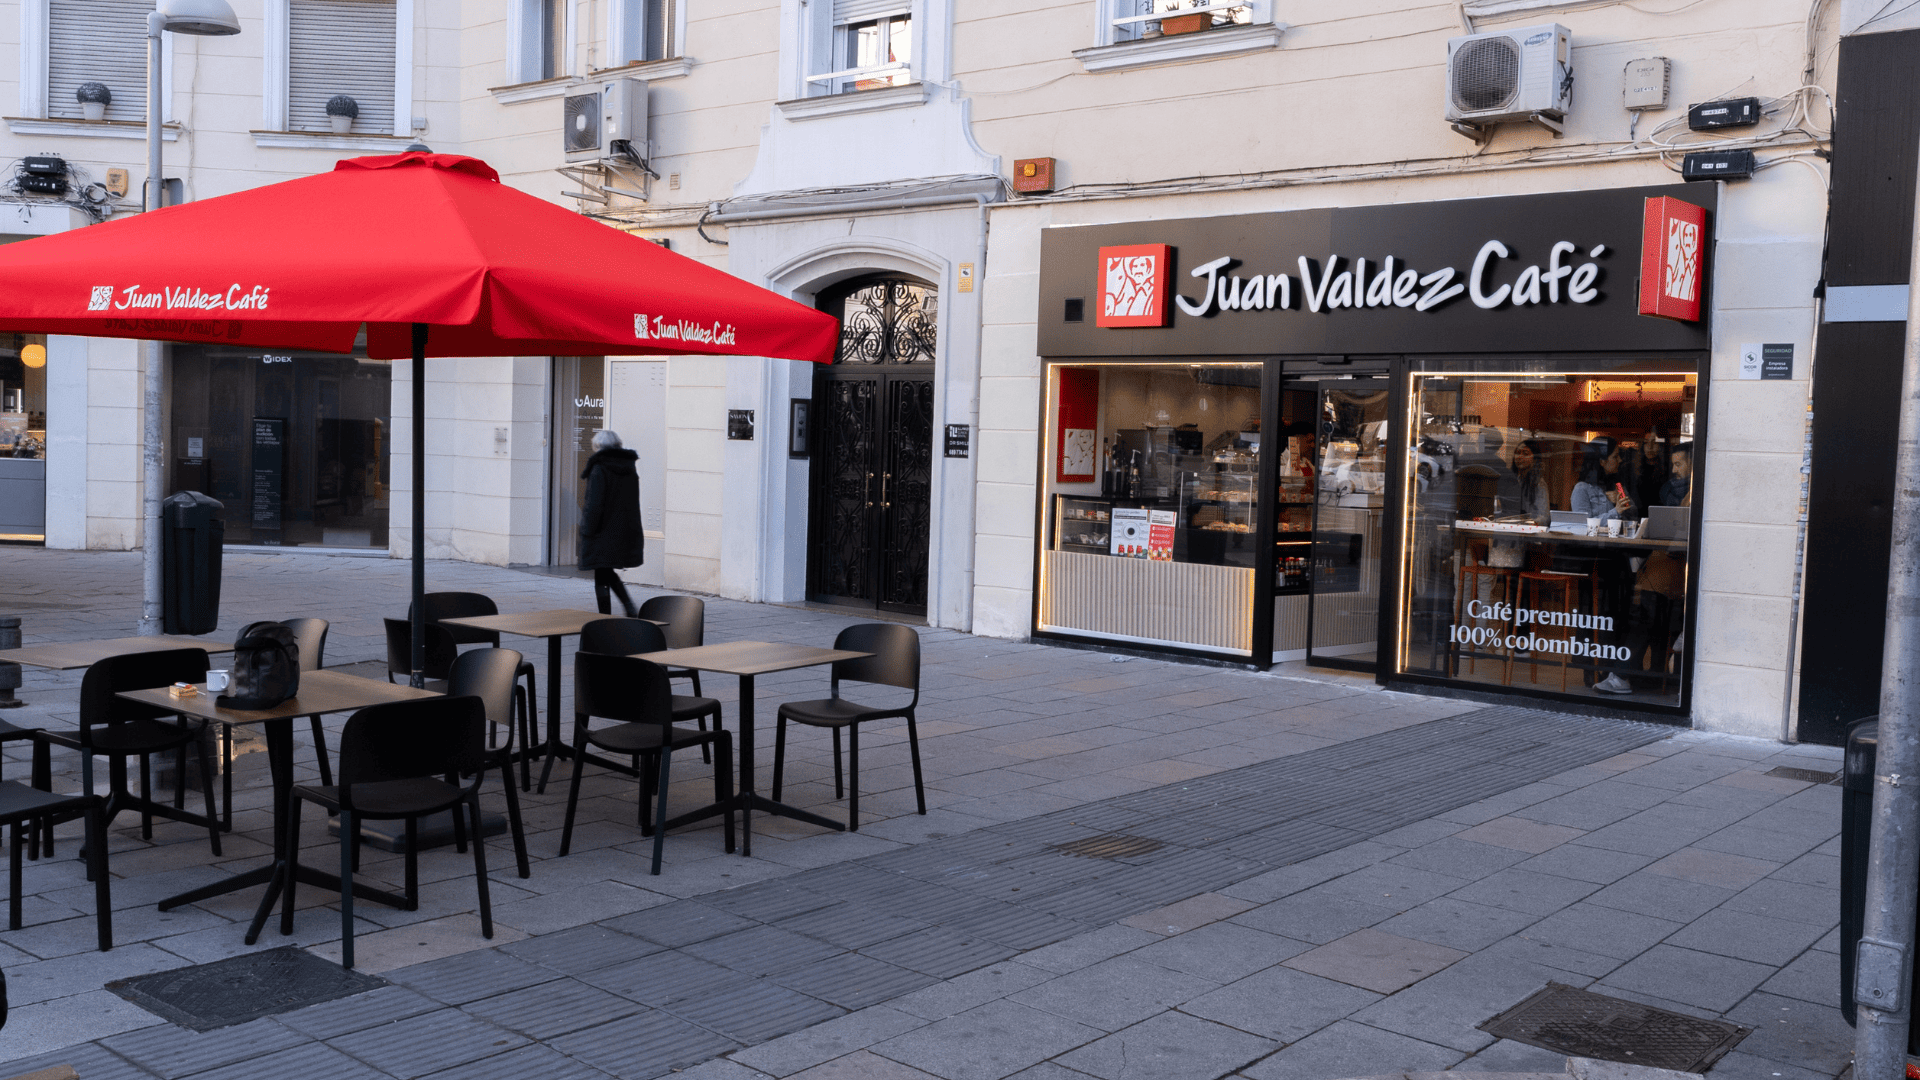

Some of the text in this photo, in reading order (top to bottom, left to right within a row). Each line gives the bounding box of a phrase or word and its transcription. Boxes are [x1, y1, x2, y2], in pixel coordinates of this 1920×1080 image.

[848, 218, 856, 236] 7
[1175, 239, 1606, 317] Juan Valdez Café
[114, 283, 270, 310] Juan Valdez Café
[650, 315, 736, 345] Juan Valdez Café
[263, 354, 292, 364] WIDEX
[583, 394, 604, 408] Aura
[1467, 599, 1614, 632] Café premium
[1449, 624, 1631, 661] 100% colombiano
